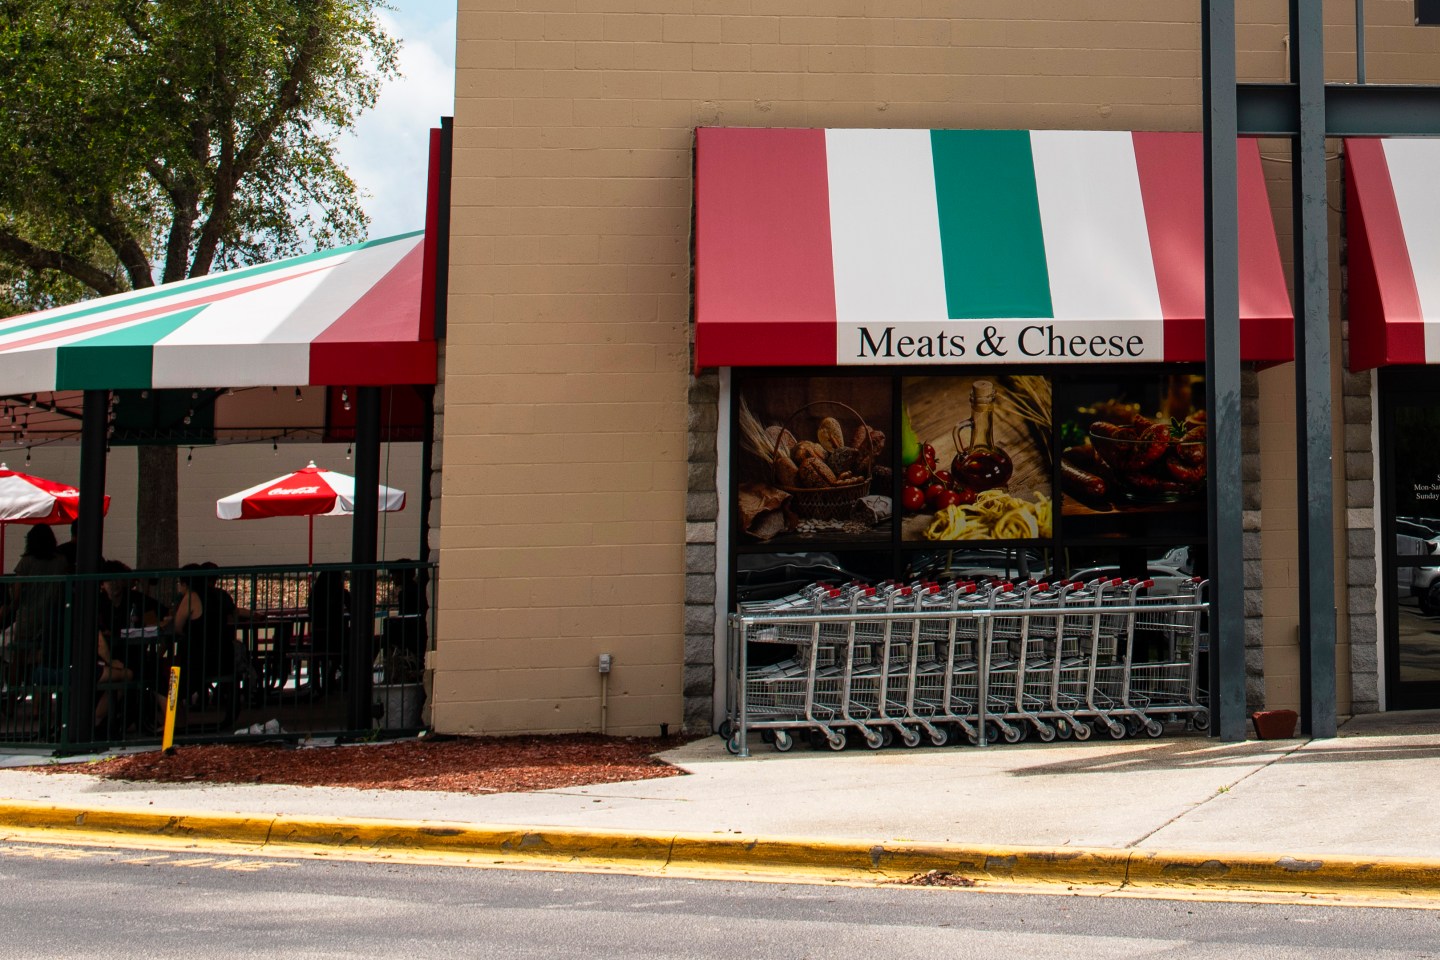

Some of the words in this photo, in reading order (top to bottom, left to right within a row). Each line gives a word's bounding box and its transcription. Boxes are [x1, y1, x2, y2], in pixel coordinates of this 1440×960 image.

[856, 326, 966, 358] Meats
[975, 325, 1008, 357] &
[1017, 324, 1145, 357] Cheese
[1416, 492, 1440, 501] Sunday
